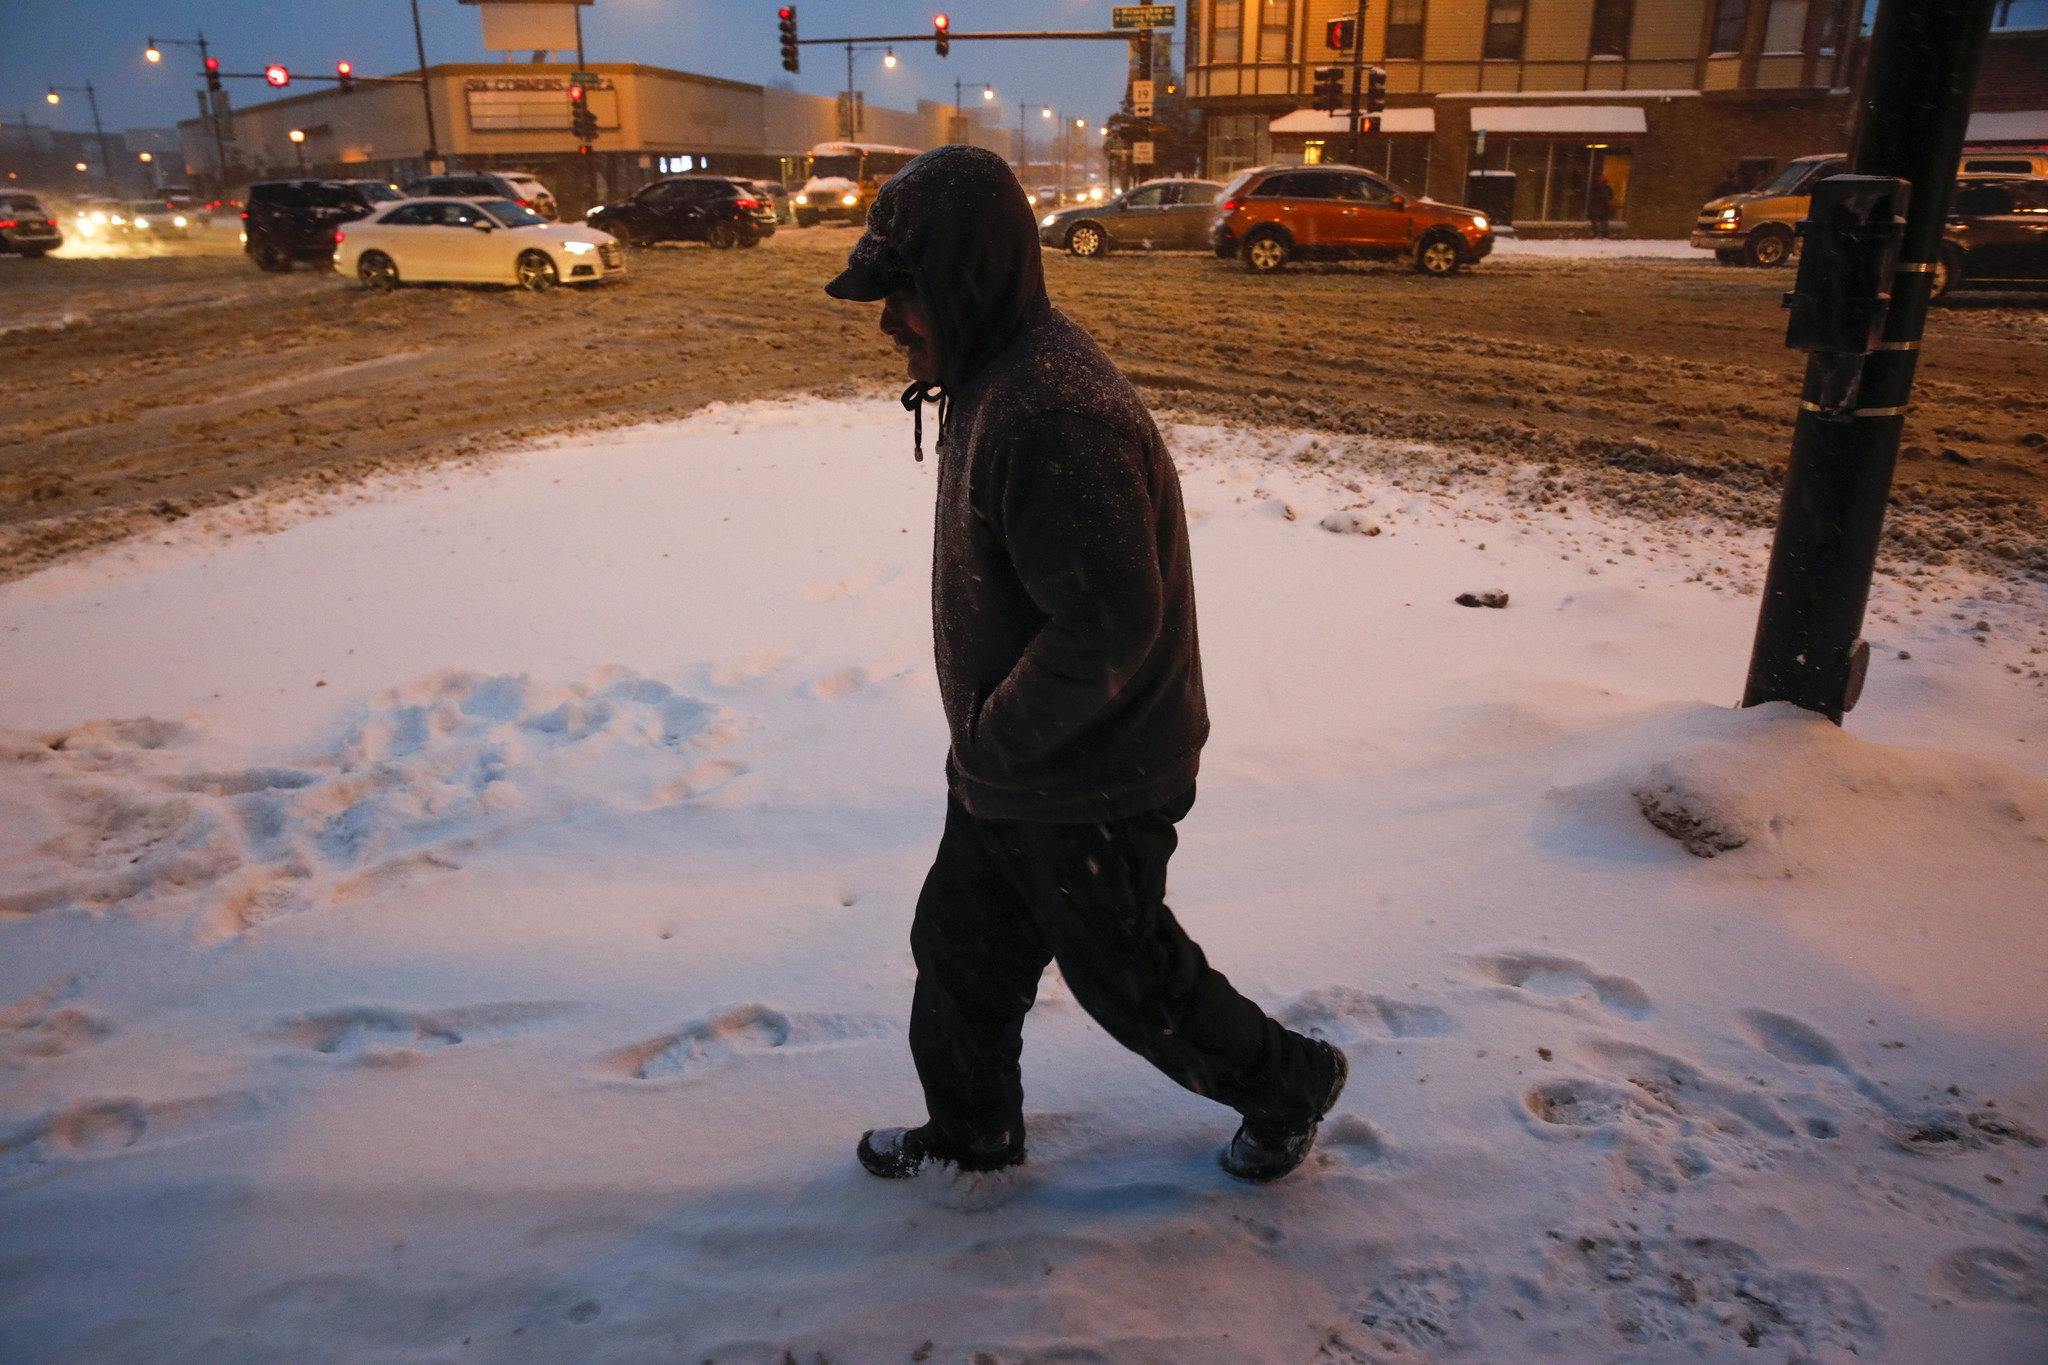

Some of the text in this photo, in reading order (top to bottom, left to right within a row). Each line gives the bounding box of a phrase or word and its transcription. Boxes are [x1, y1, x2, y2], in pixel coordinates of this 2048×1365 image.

[466, 78, 487, 90] SIX
[495, 78, 562, 90] CORNERS
[1137, 89, 1149, 99] 19
